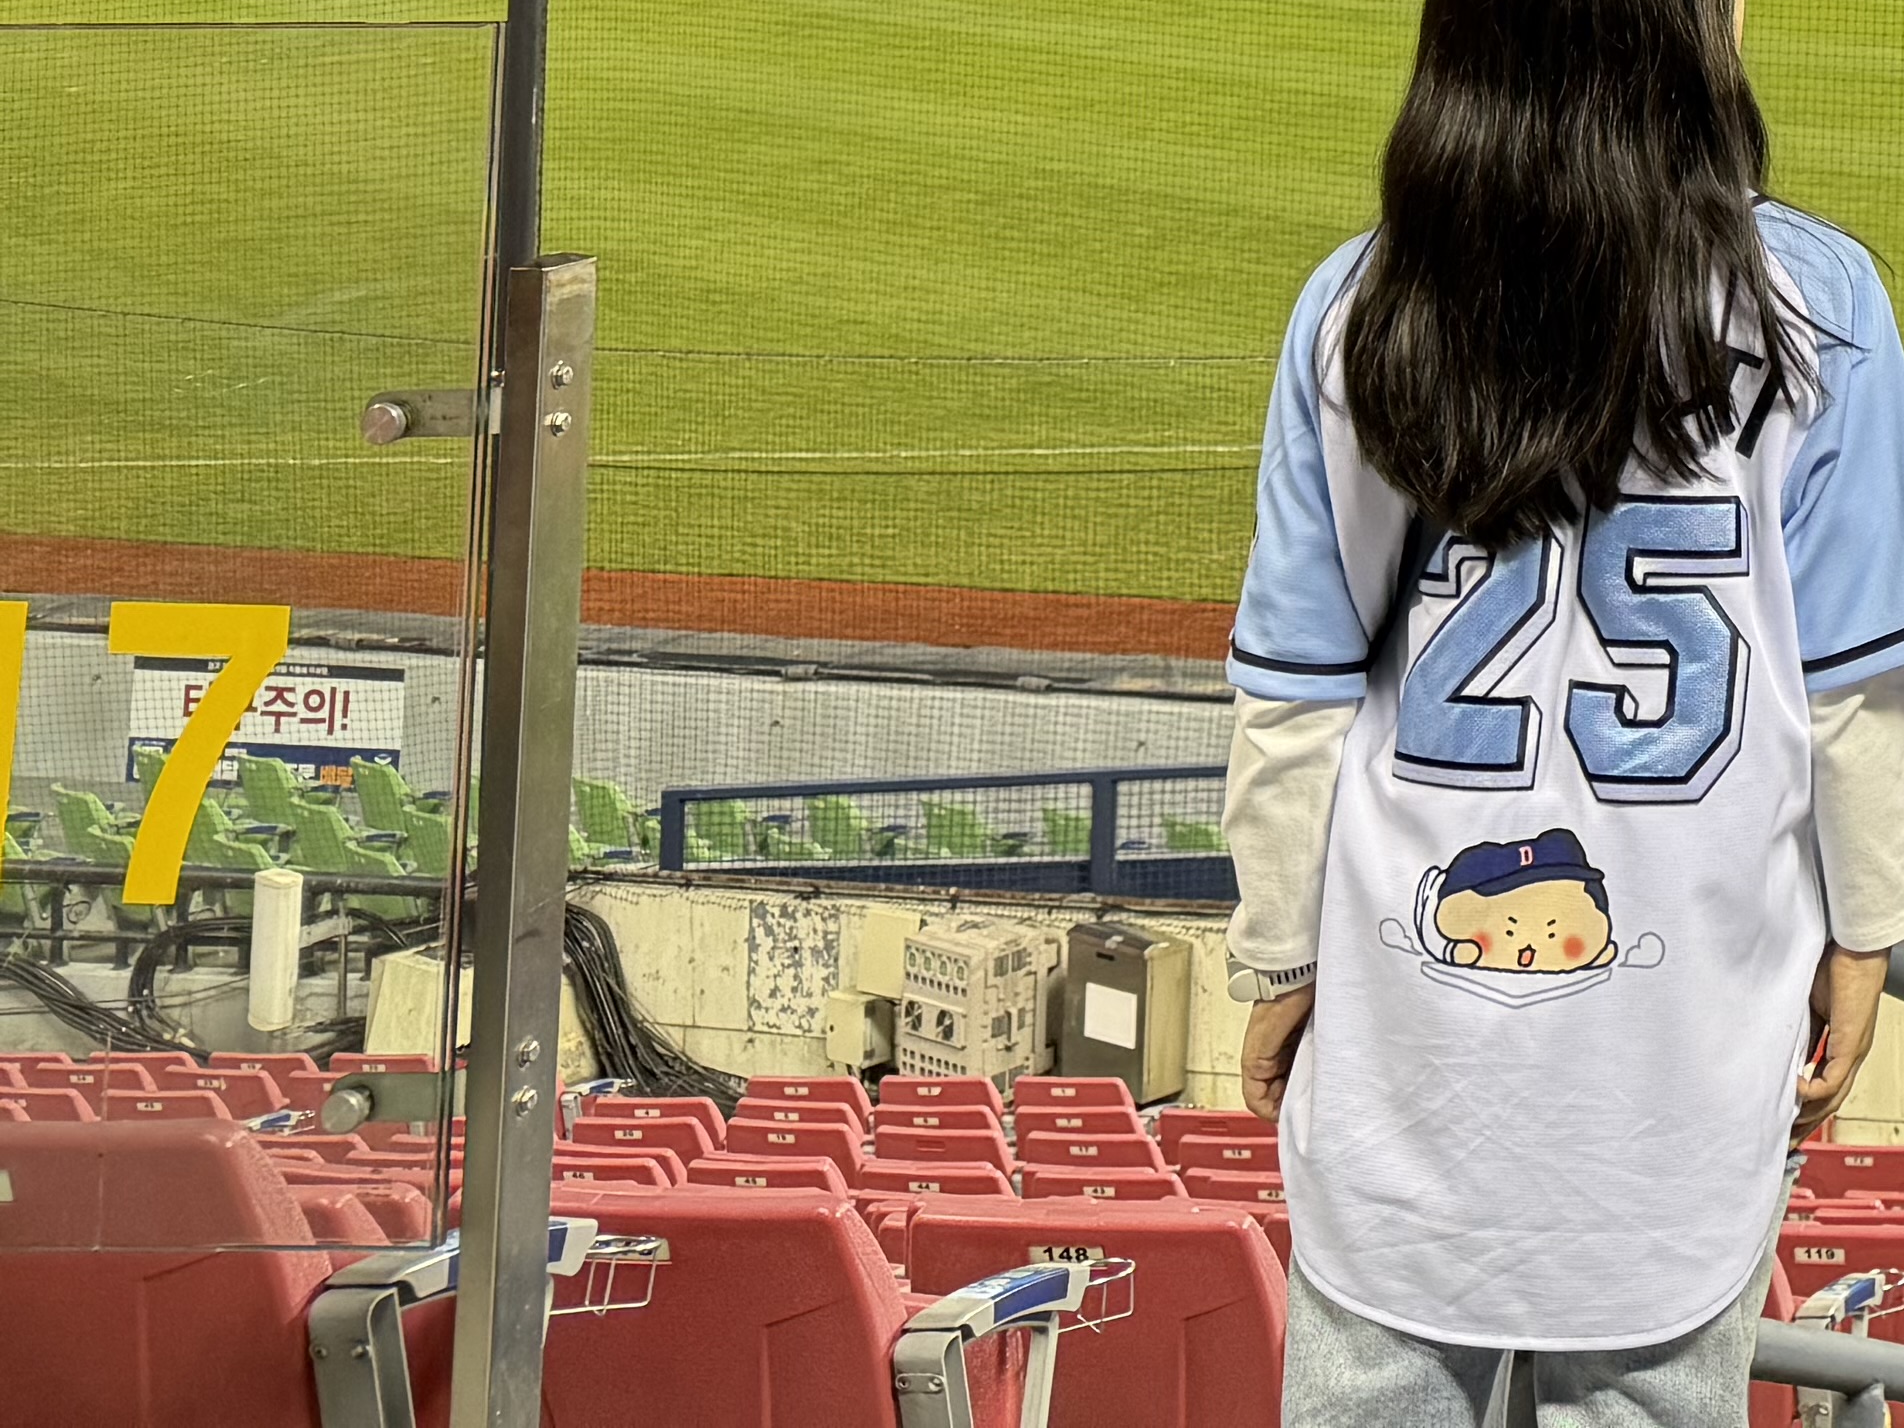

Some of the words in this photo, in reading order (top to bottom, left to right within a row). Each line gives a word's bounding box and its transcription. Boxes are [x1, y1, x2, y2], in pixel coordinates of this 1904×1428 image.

[1393, 494, 1750, 805] 25
[182, 684, 350, 736] 주의!
[1803, 1247, 1836, 1261] 119
